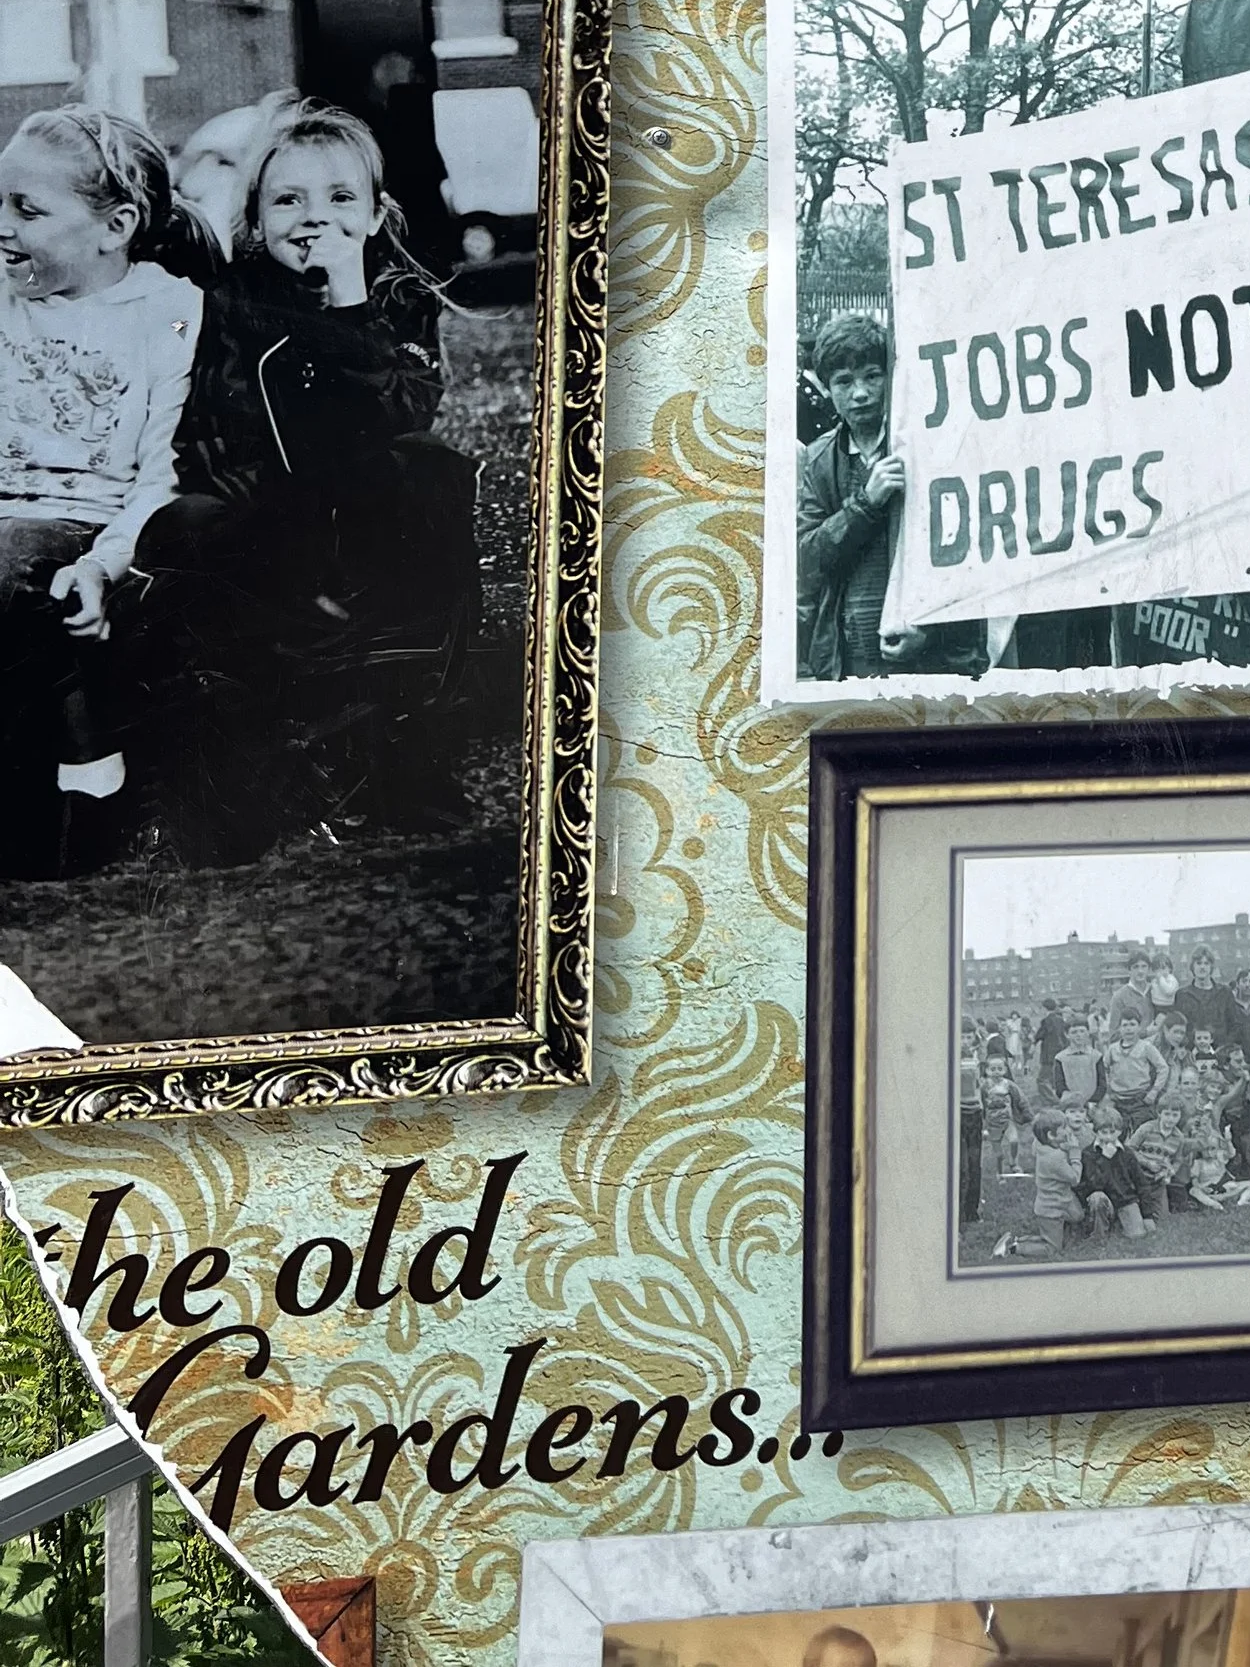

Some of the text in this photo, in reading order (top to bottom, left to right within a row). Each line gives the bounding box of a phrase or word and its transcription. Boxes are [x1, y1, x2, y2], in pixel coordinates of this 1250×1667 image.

[903, 176, 967, 270] ST
[918, 317, 1092, 429] JOBS
[929, 450, 1165, 567] DRUGS
[275, 1151, 529, 1316] old
